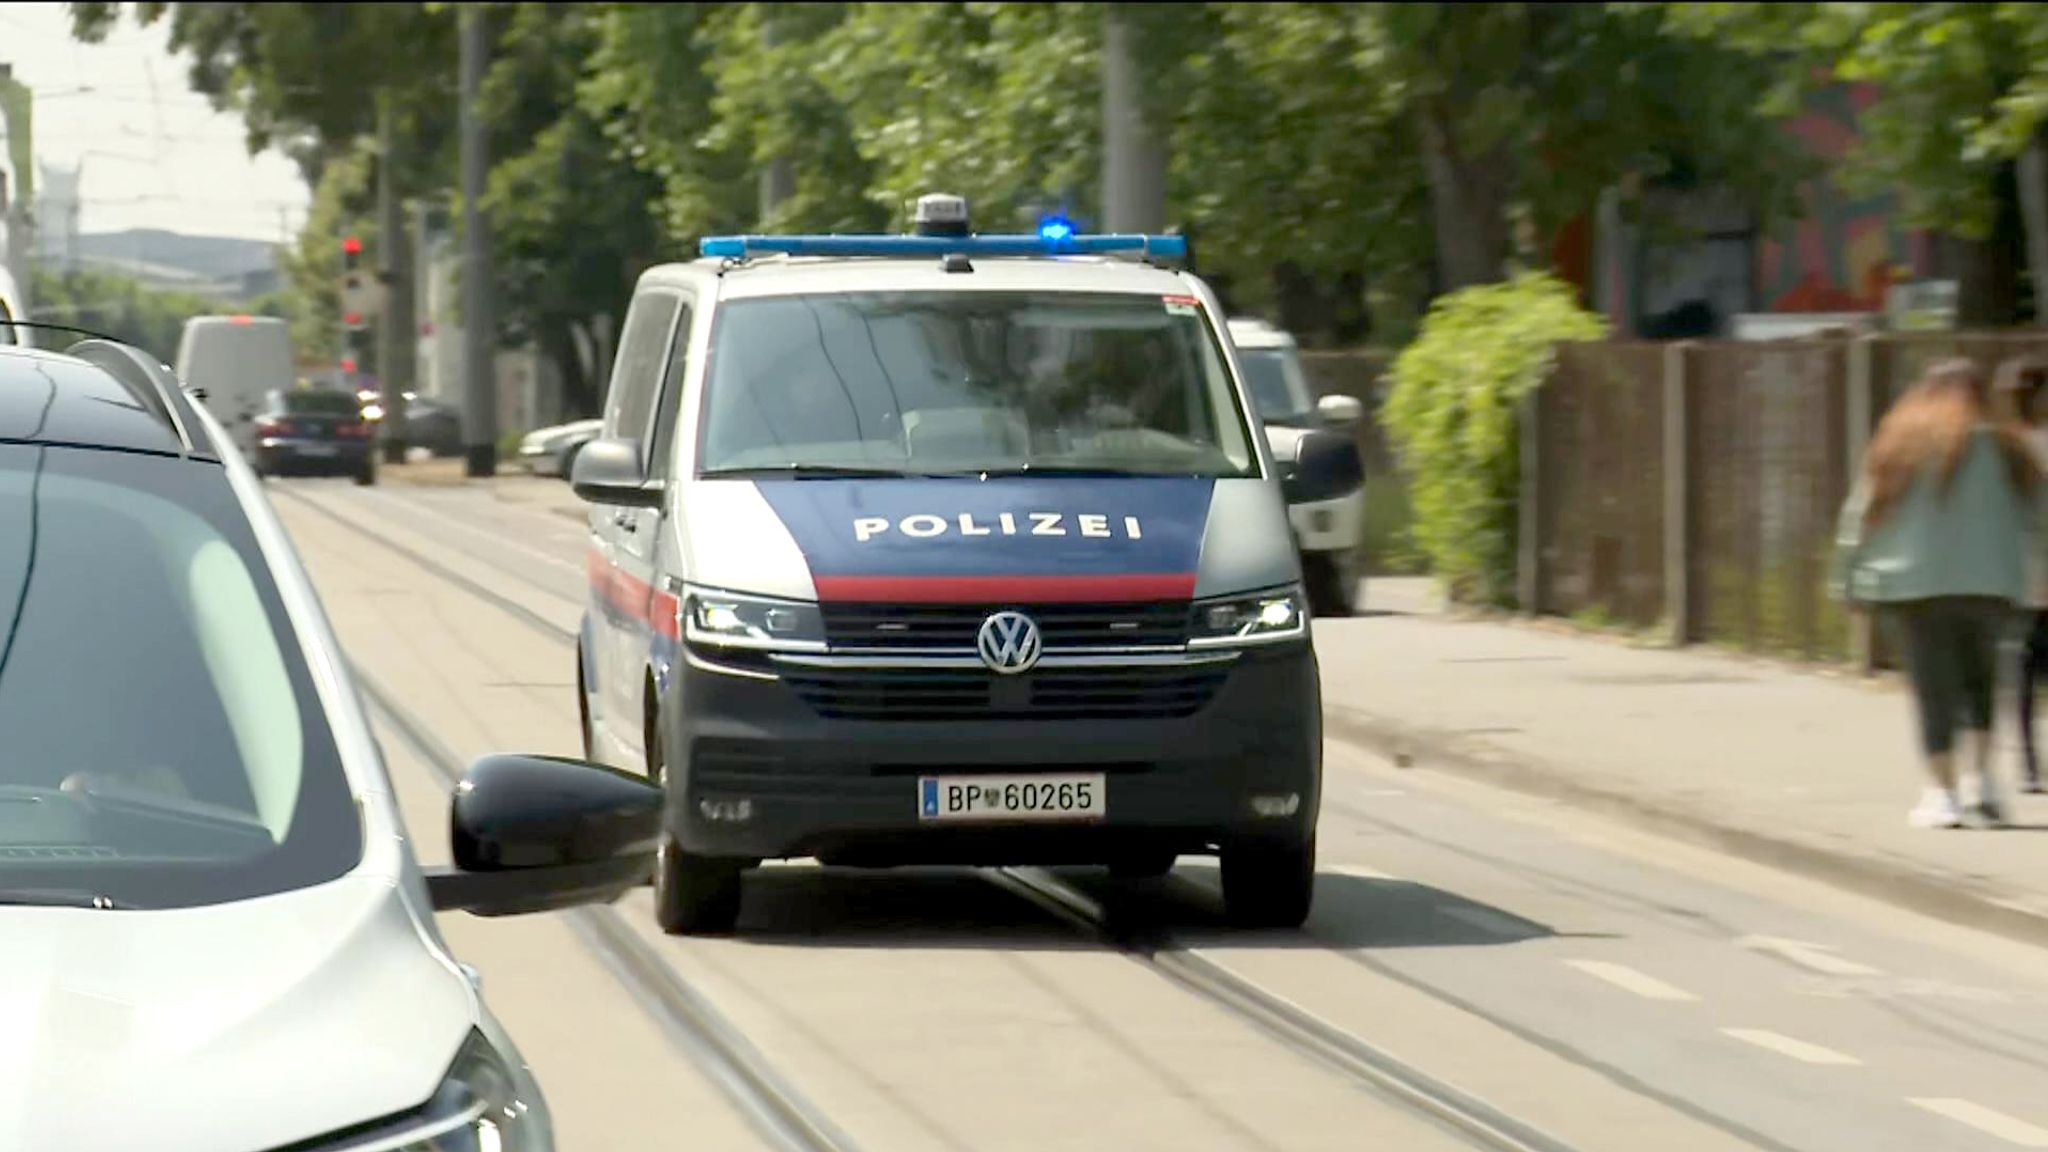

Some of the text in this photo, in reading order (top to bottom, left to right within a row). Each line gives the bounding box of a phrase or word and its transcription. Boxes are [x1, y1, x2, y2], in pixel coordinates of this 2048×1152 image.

[853, 512, 1142, 541] POLIZEI
[948, 782, 1092, 812] BP 60265
